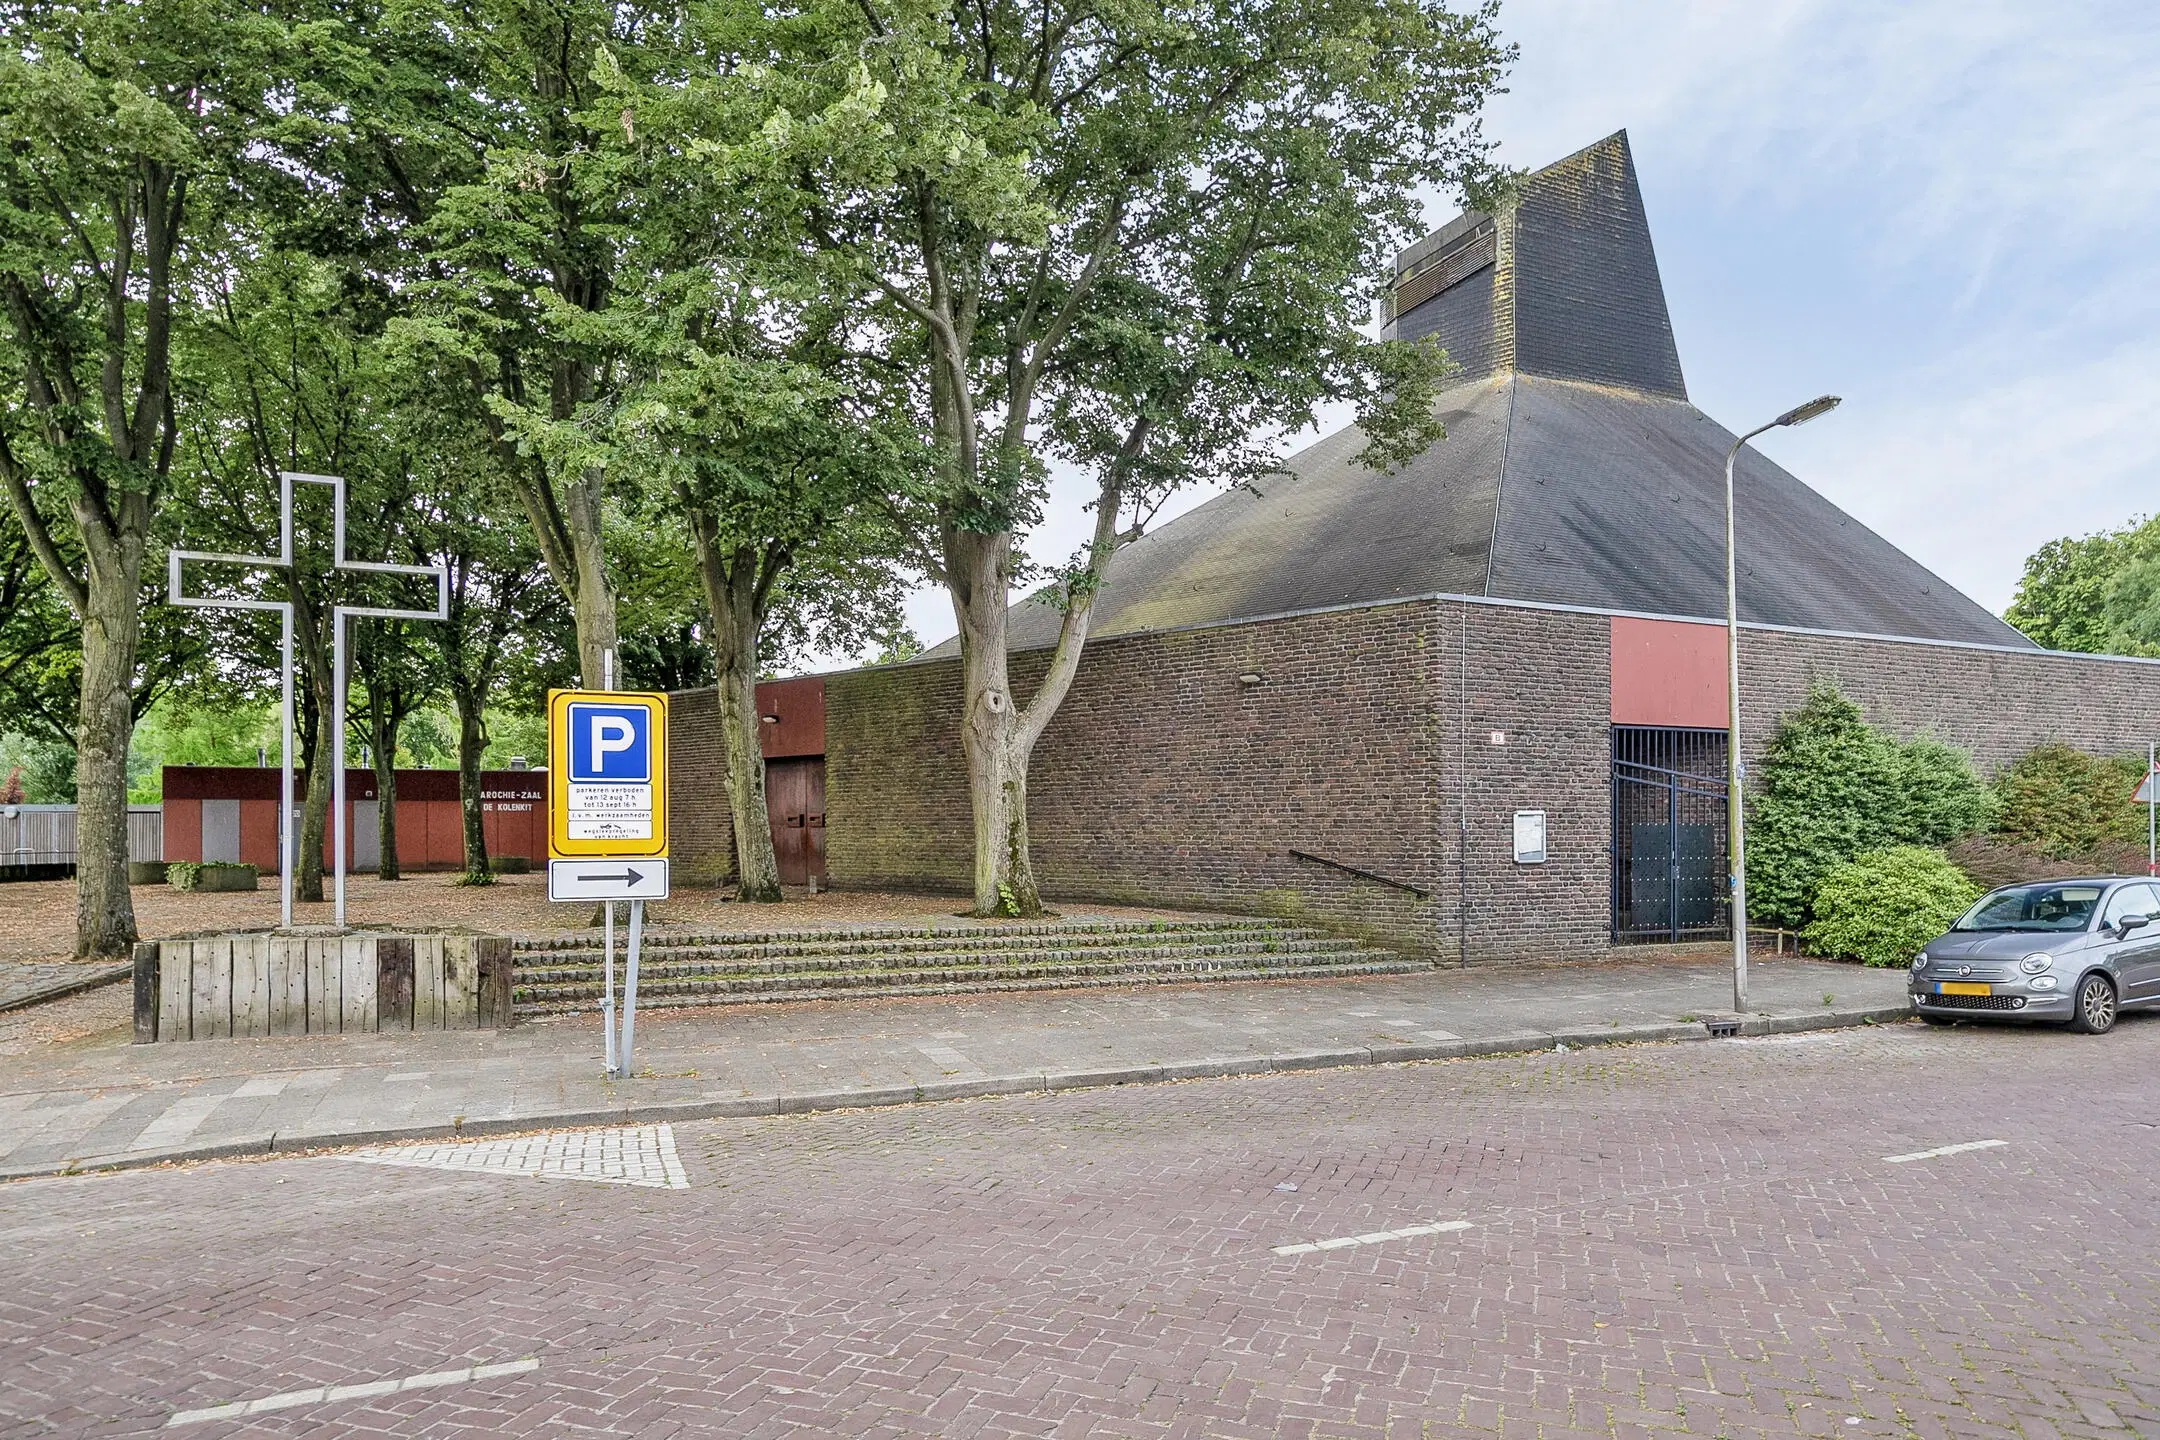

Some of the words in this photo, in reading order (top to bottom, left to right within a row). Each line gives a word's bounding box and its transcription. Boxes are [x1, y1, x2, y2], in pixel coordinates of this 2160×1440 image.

[591, 715, 636, 772] P
[480, 791, 542, 799] AROCHIE-ZAAL
[483, 803, 493, 811] DE
[497, 803, 532, 811] KOLENKIT
